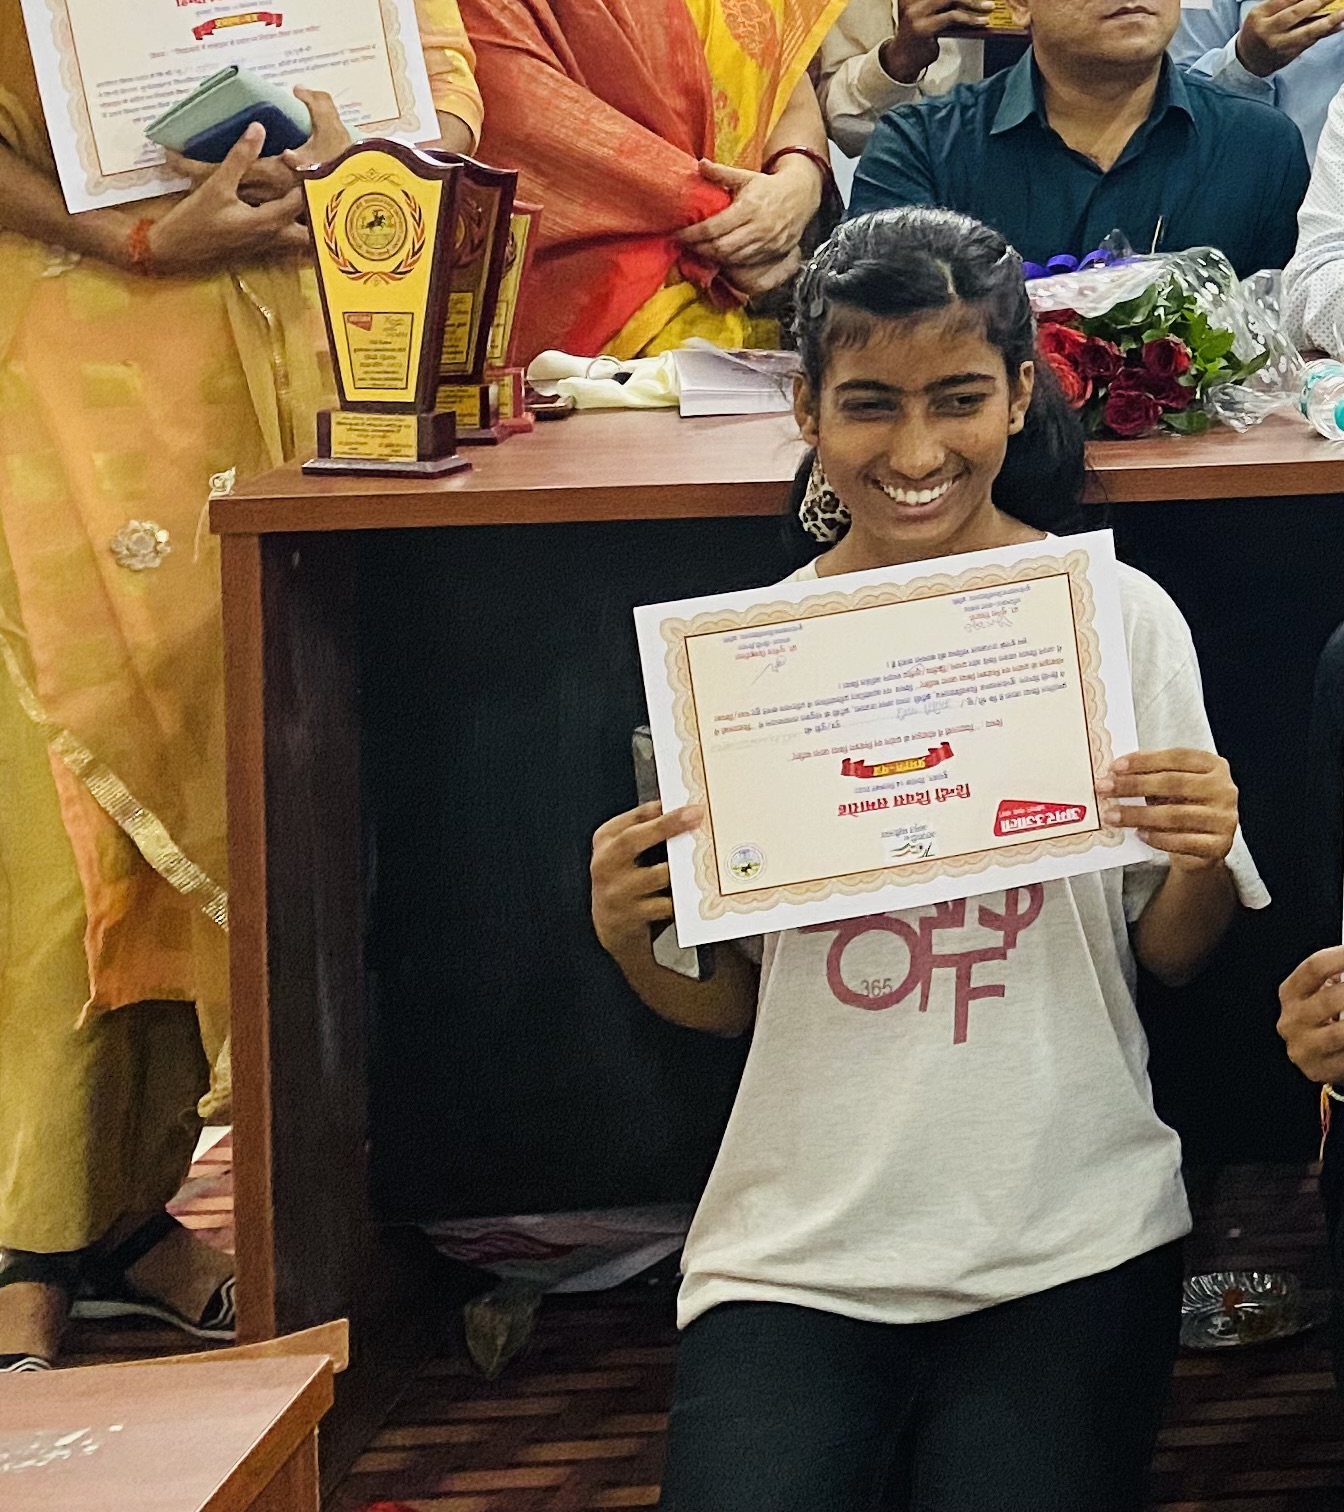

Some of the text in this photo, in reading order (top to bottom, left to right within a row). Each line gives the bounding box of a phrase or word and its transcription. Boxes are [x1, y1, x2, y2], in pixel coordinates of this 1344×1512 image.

[836, 783, 970, 820] हिन्दी दिवस समारोह
[999, 812, 1046, 832] उजाला
[1045, 806, 1081, 824] अमर
[860, 978, 893, 998] 365
